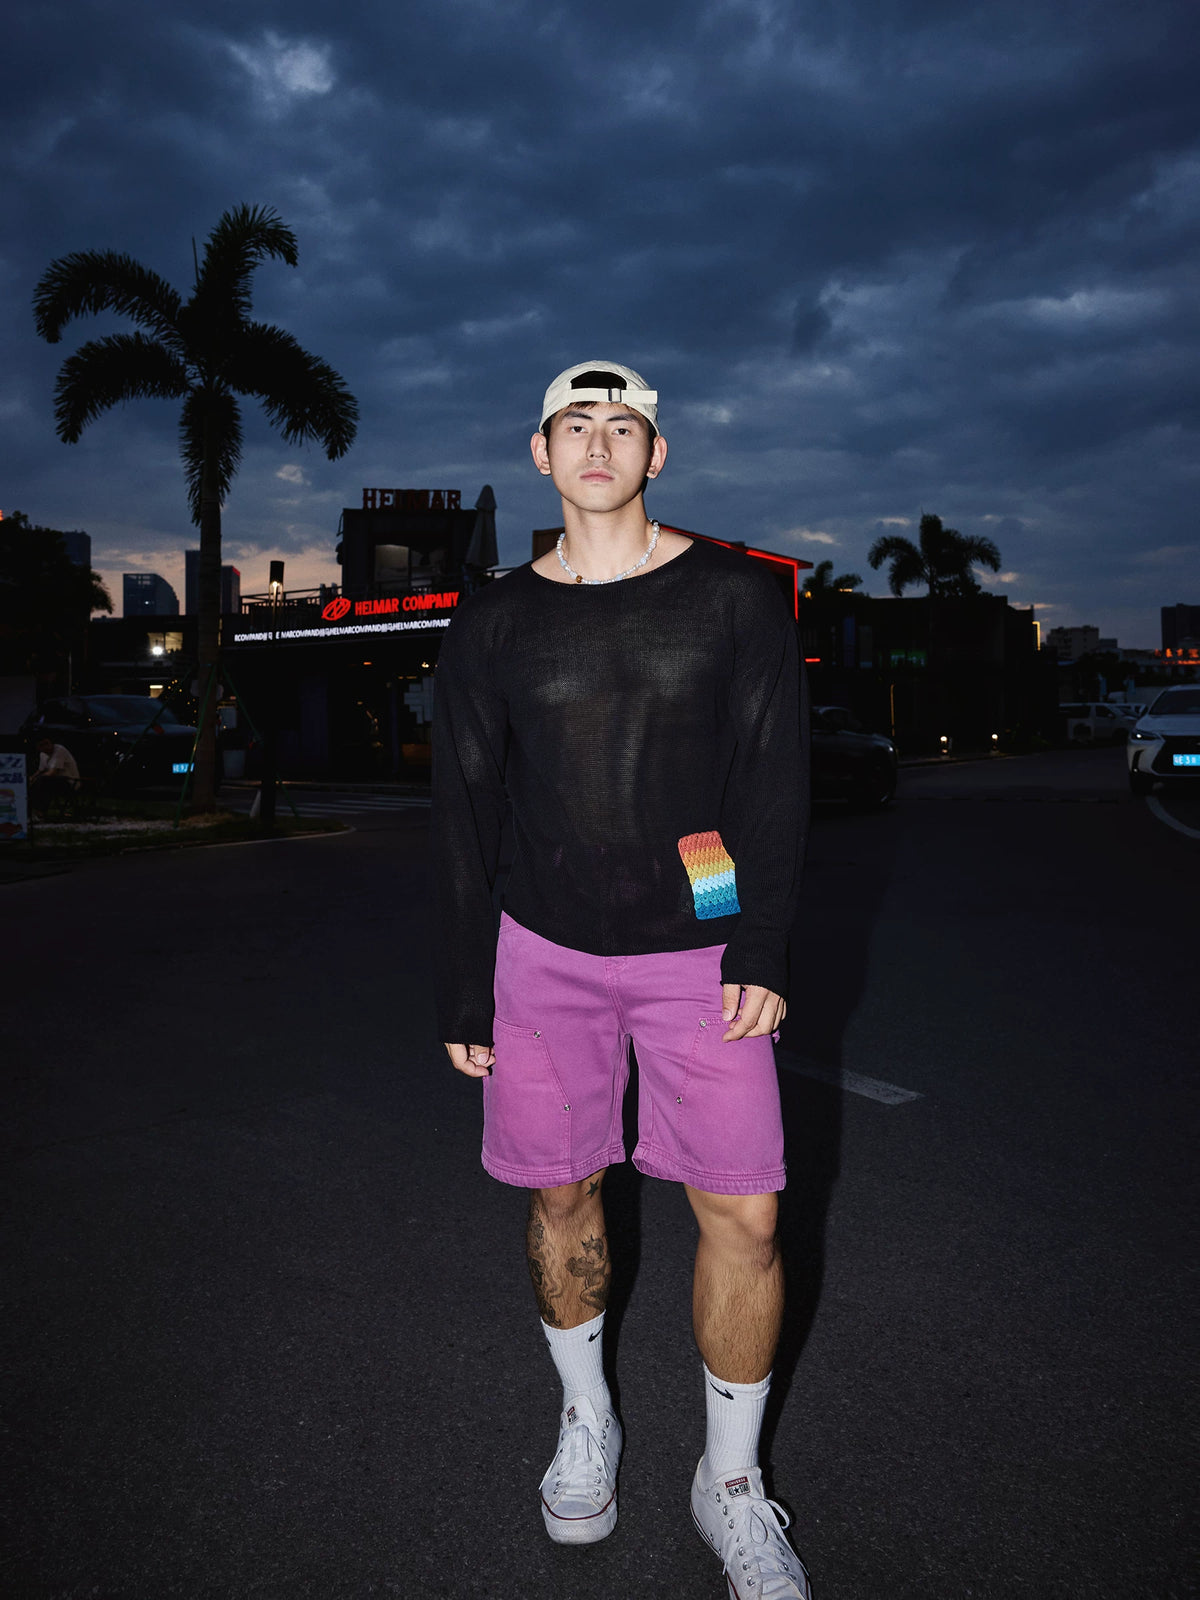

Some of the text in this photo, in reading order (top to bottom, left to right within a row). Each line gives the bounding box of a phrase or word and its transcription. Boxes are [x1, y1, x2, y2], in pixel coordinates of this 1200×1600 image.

[363, 488, 461, 511] HELMAR
[354, 591, 460, 616] HELMAR COMPANY
